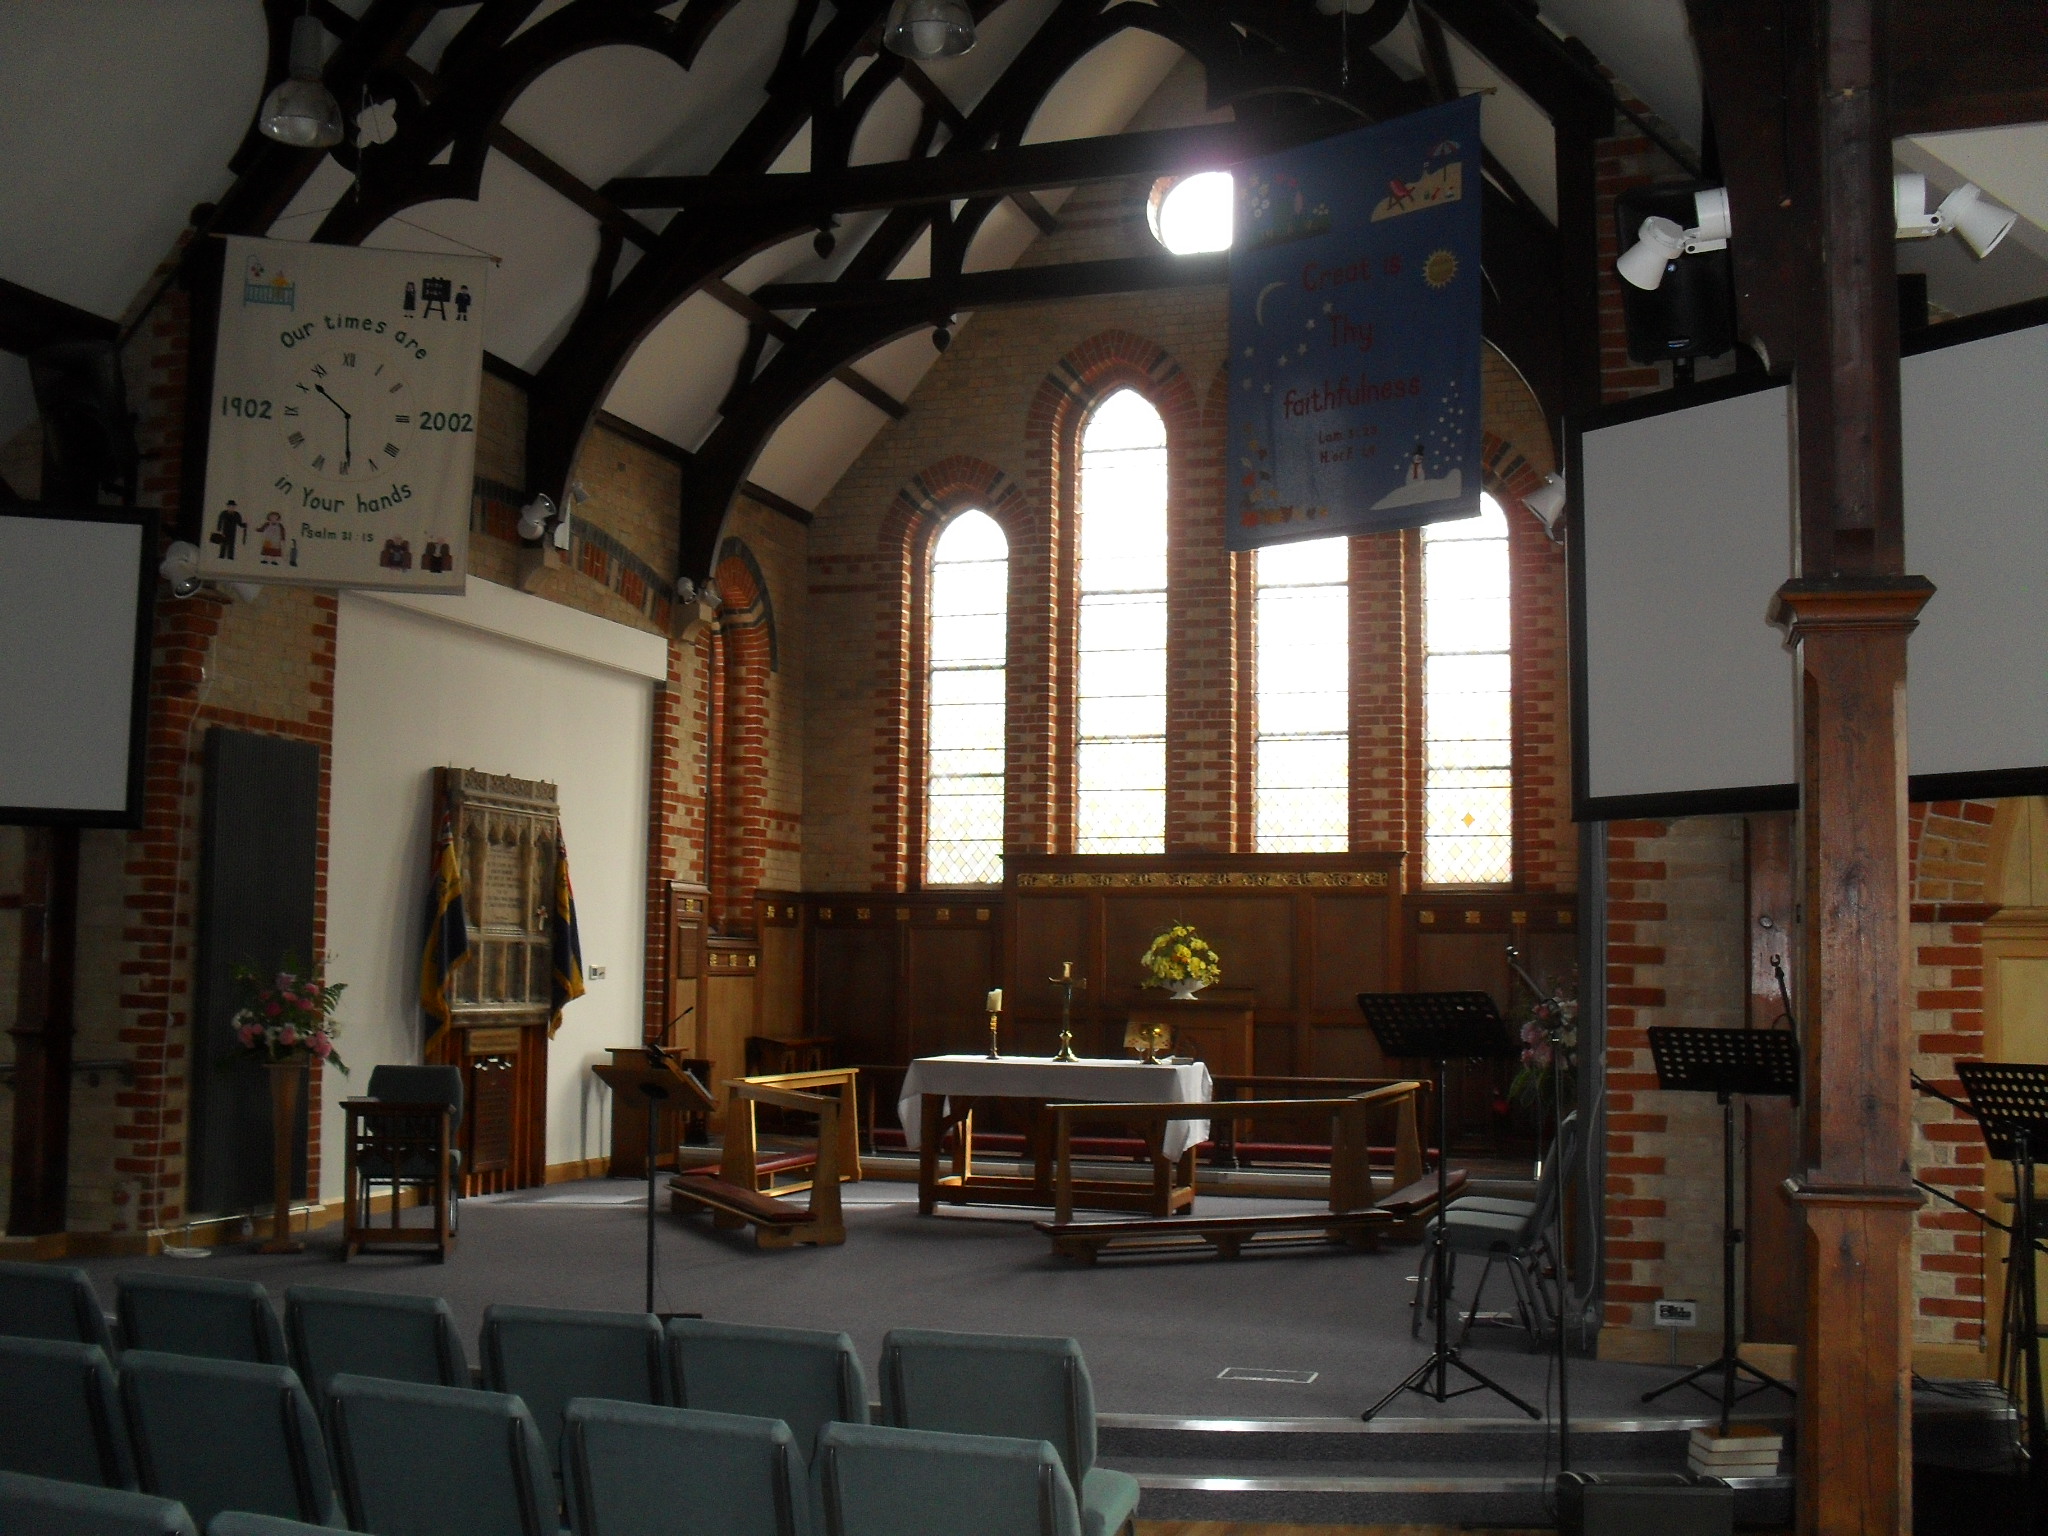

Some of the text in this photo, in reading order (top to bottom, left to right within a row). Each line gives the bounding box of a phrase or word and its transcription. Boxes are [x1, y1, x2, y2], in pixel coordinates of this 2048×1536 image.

[281, 314, 427, 359] Our times are
[1328, 313, 1375, 353] Thy
[222, 396, 272, 419] 1902
[1283, 373, 1421, 419] faithfulness
[420, 411, 473, 432] 2002
[274, 474, 412, 513] in Your hands
[301, 522, 336, 539] Psalm
